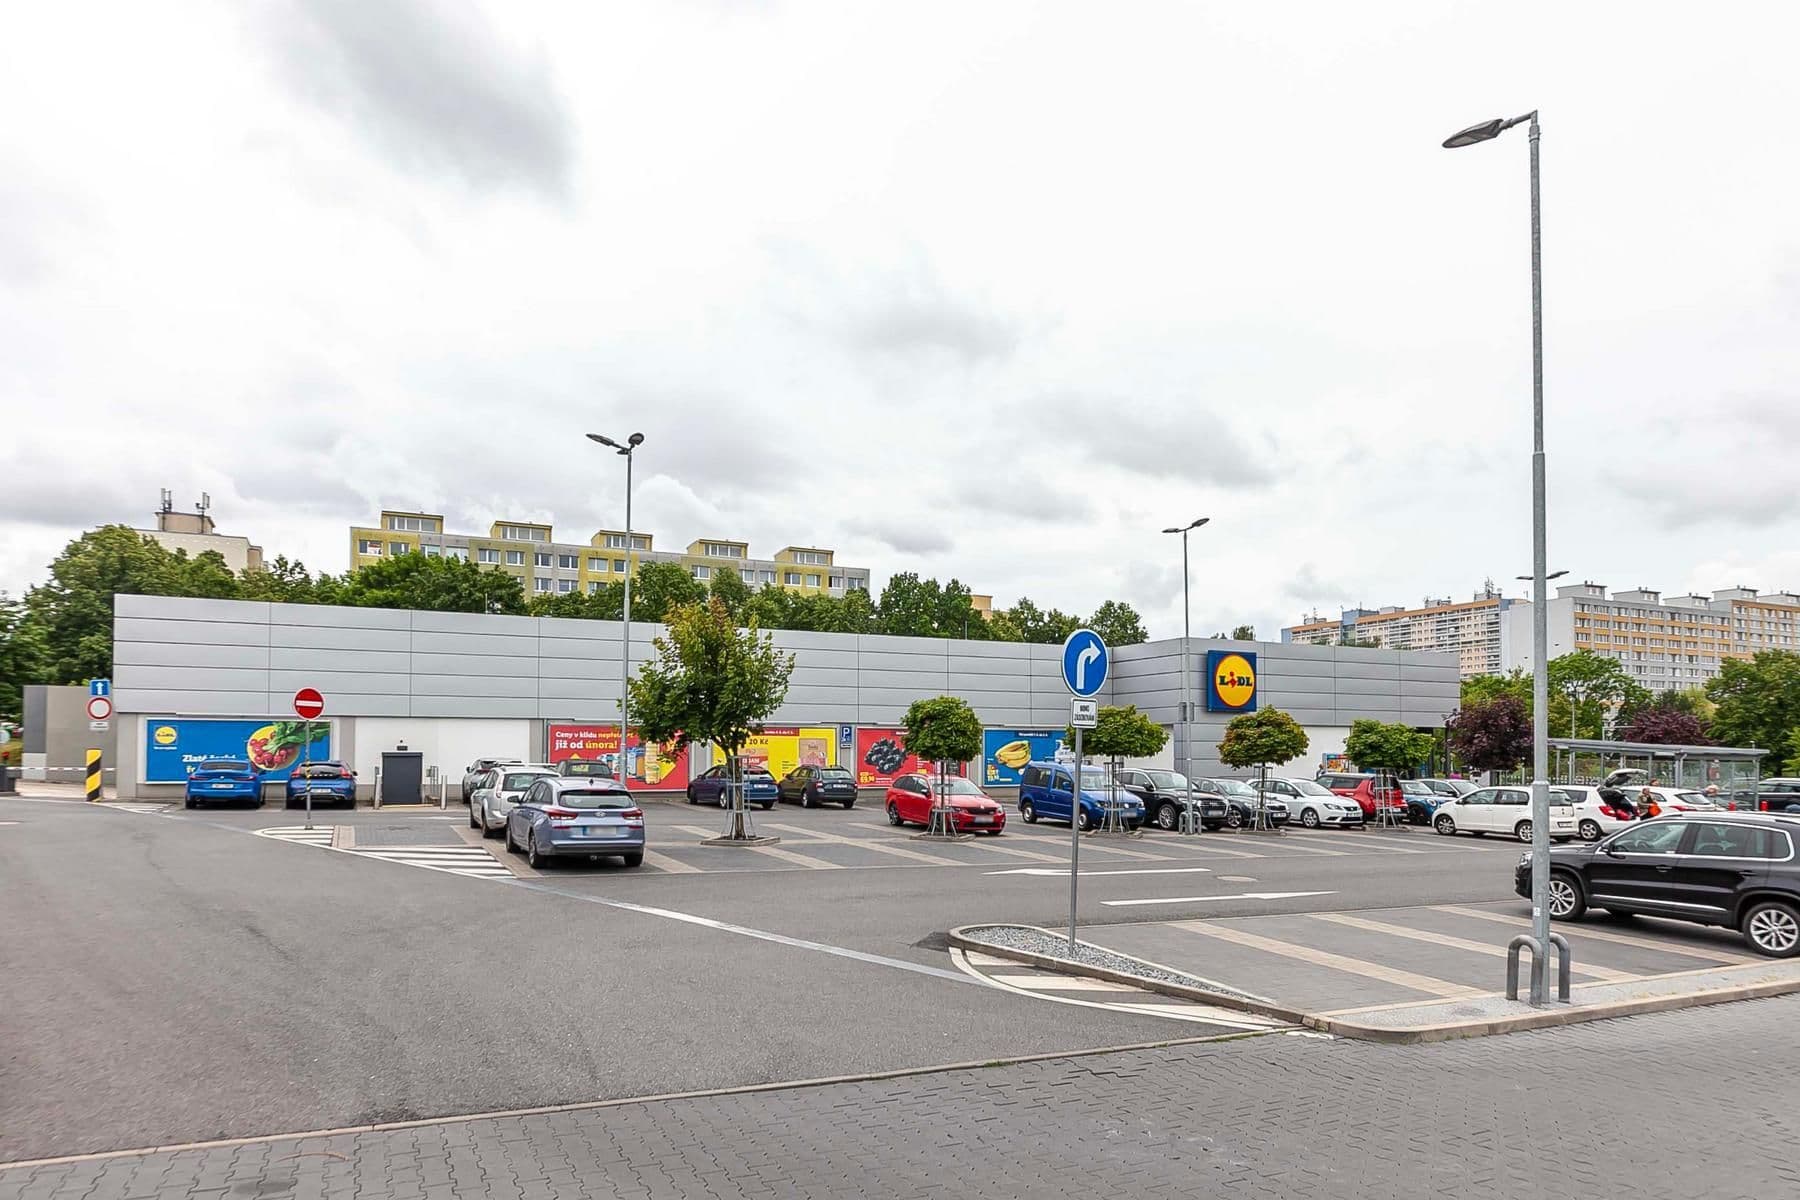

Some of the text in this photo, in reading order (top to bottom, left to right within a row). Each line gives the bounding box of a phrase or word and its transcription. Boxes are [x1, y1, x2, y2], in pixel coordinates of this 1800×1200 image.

[555, 731, 573, 739] Ceny
[555, 740, 617, 750] již od února!
